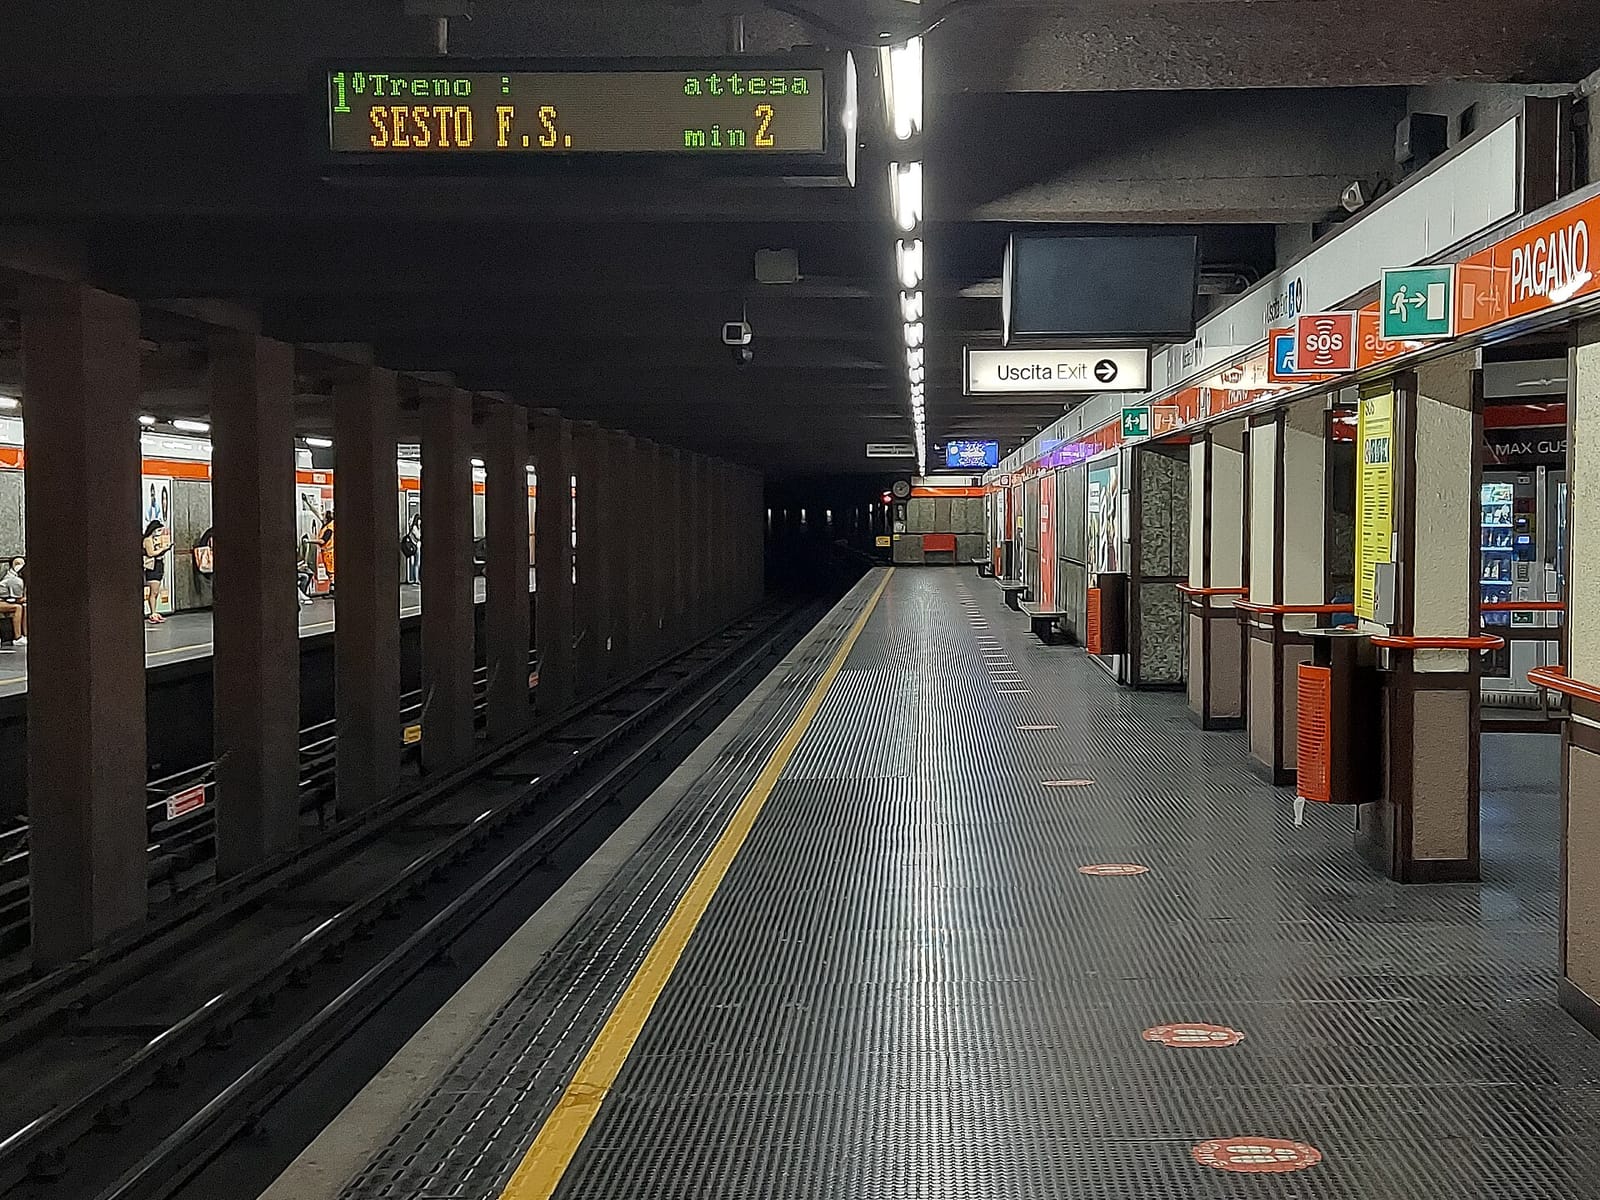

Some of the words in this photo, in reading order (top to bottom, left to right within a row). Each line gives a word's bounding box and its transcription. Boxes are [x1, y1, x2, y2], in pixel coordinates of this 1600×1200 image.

[684, 73, 809, 95] attesa
[370, 106, 472, 147] SESTO
[496, 106, 571, 147] F.S.
[684, 125, 745, 146] min
[755, 104, 774, 146] 2
[1511, 219, 1589, 304] PAGANO
[1305, 333, 1343, 351] SOS
[997, 364, 1052, 381] Uscita
[1056, 363, 1088, 380] Exit
[1495, 441, 1533, 456] MAX
